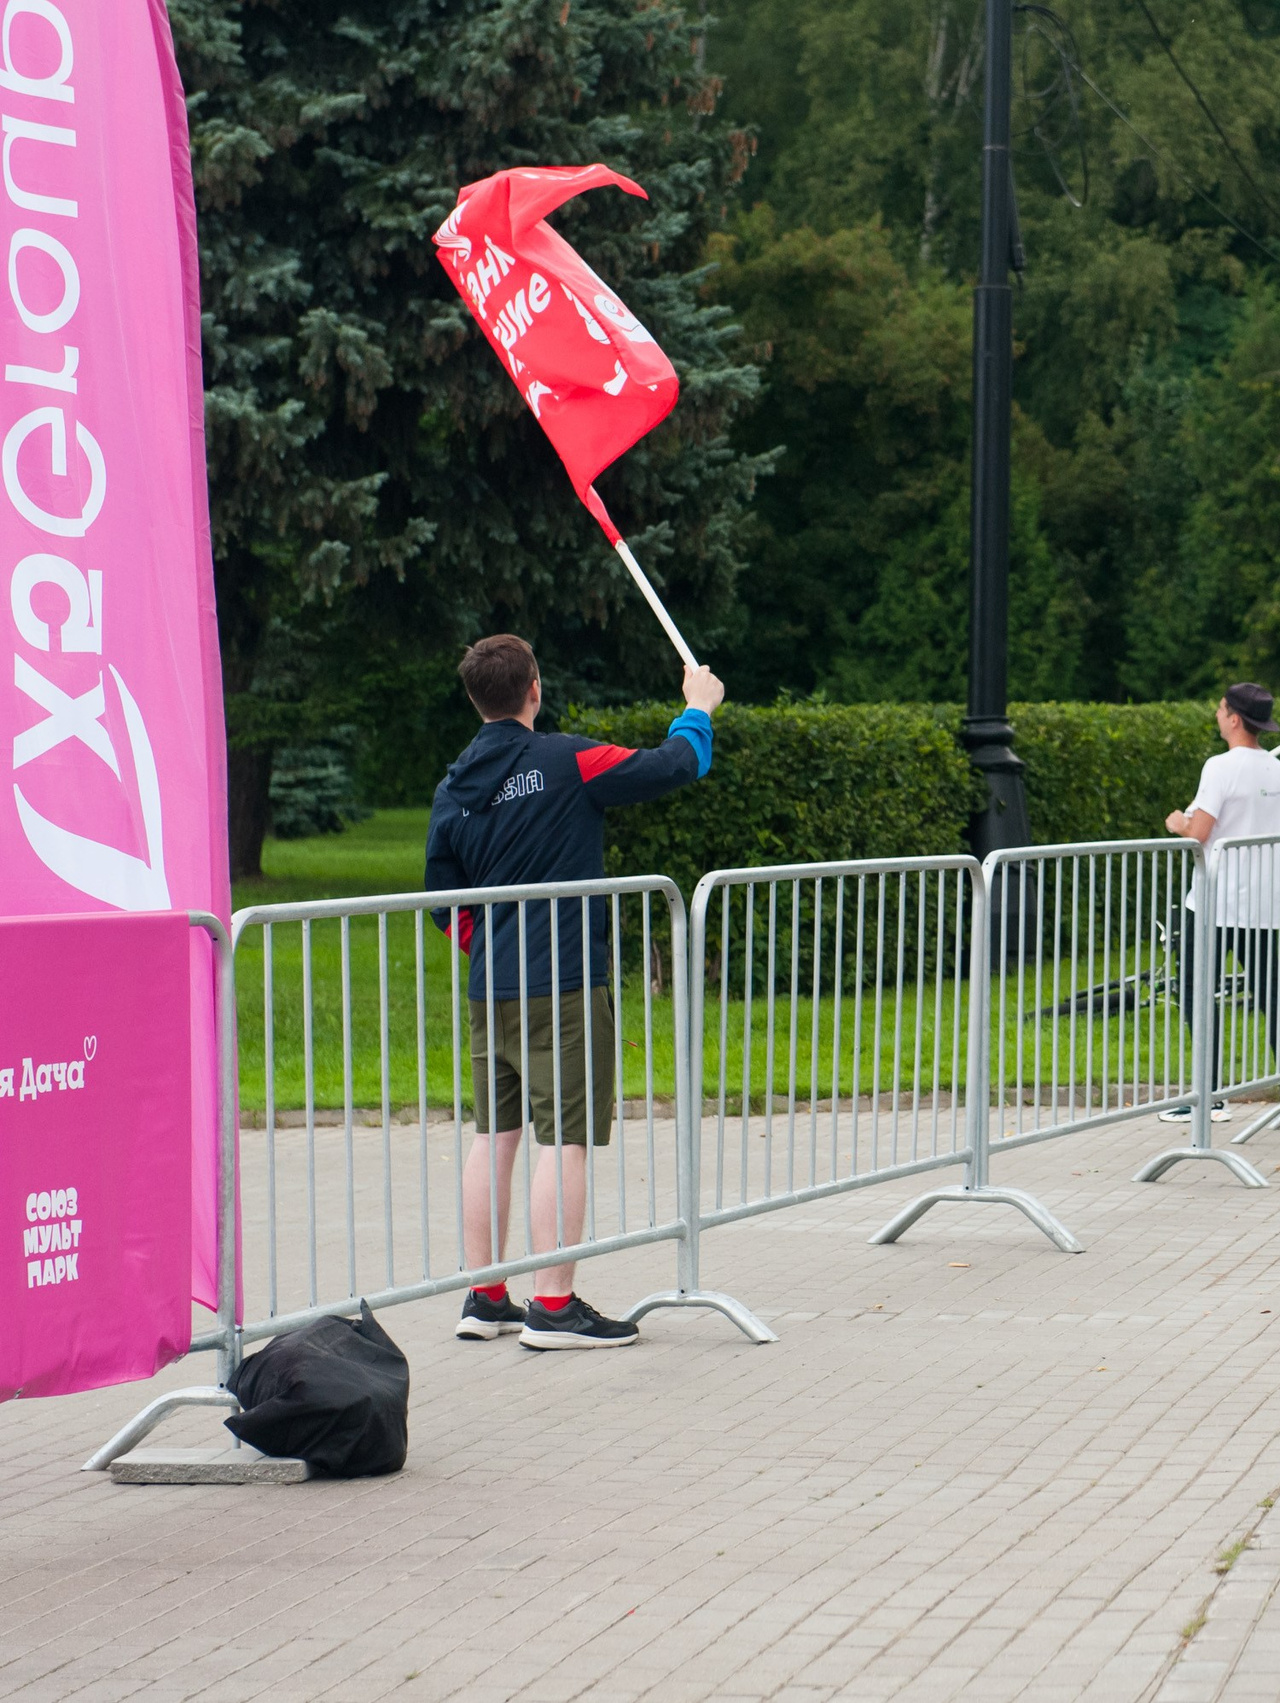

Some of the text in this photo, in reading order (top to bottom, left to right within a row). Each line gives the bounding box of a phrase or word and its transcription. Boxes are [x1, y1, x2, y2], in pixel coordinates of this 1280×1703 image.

[19, 1057, 85, 1102] Дача
[26, 1187, 78, 1222] СОЮЗ
[23, 1219, 83, 1258] МУЛЬТ
[27, 1252, 79, 1289] ПАРК
